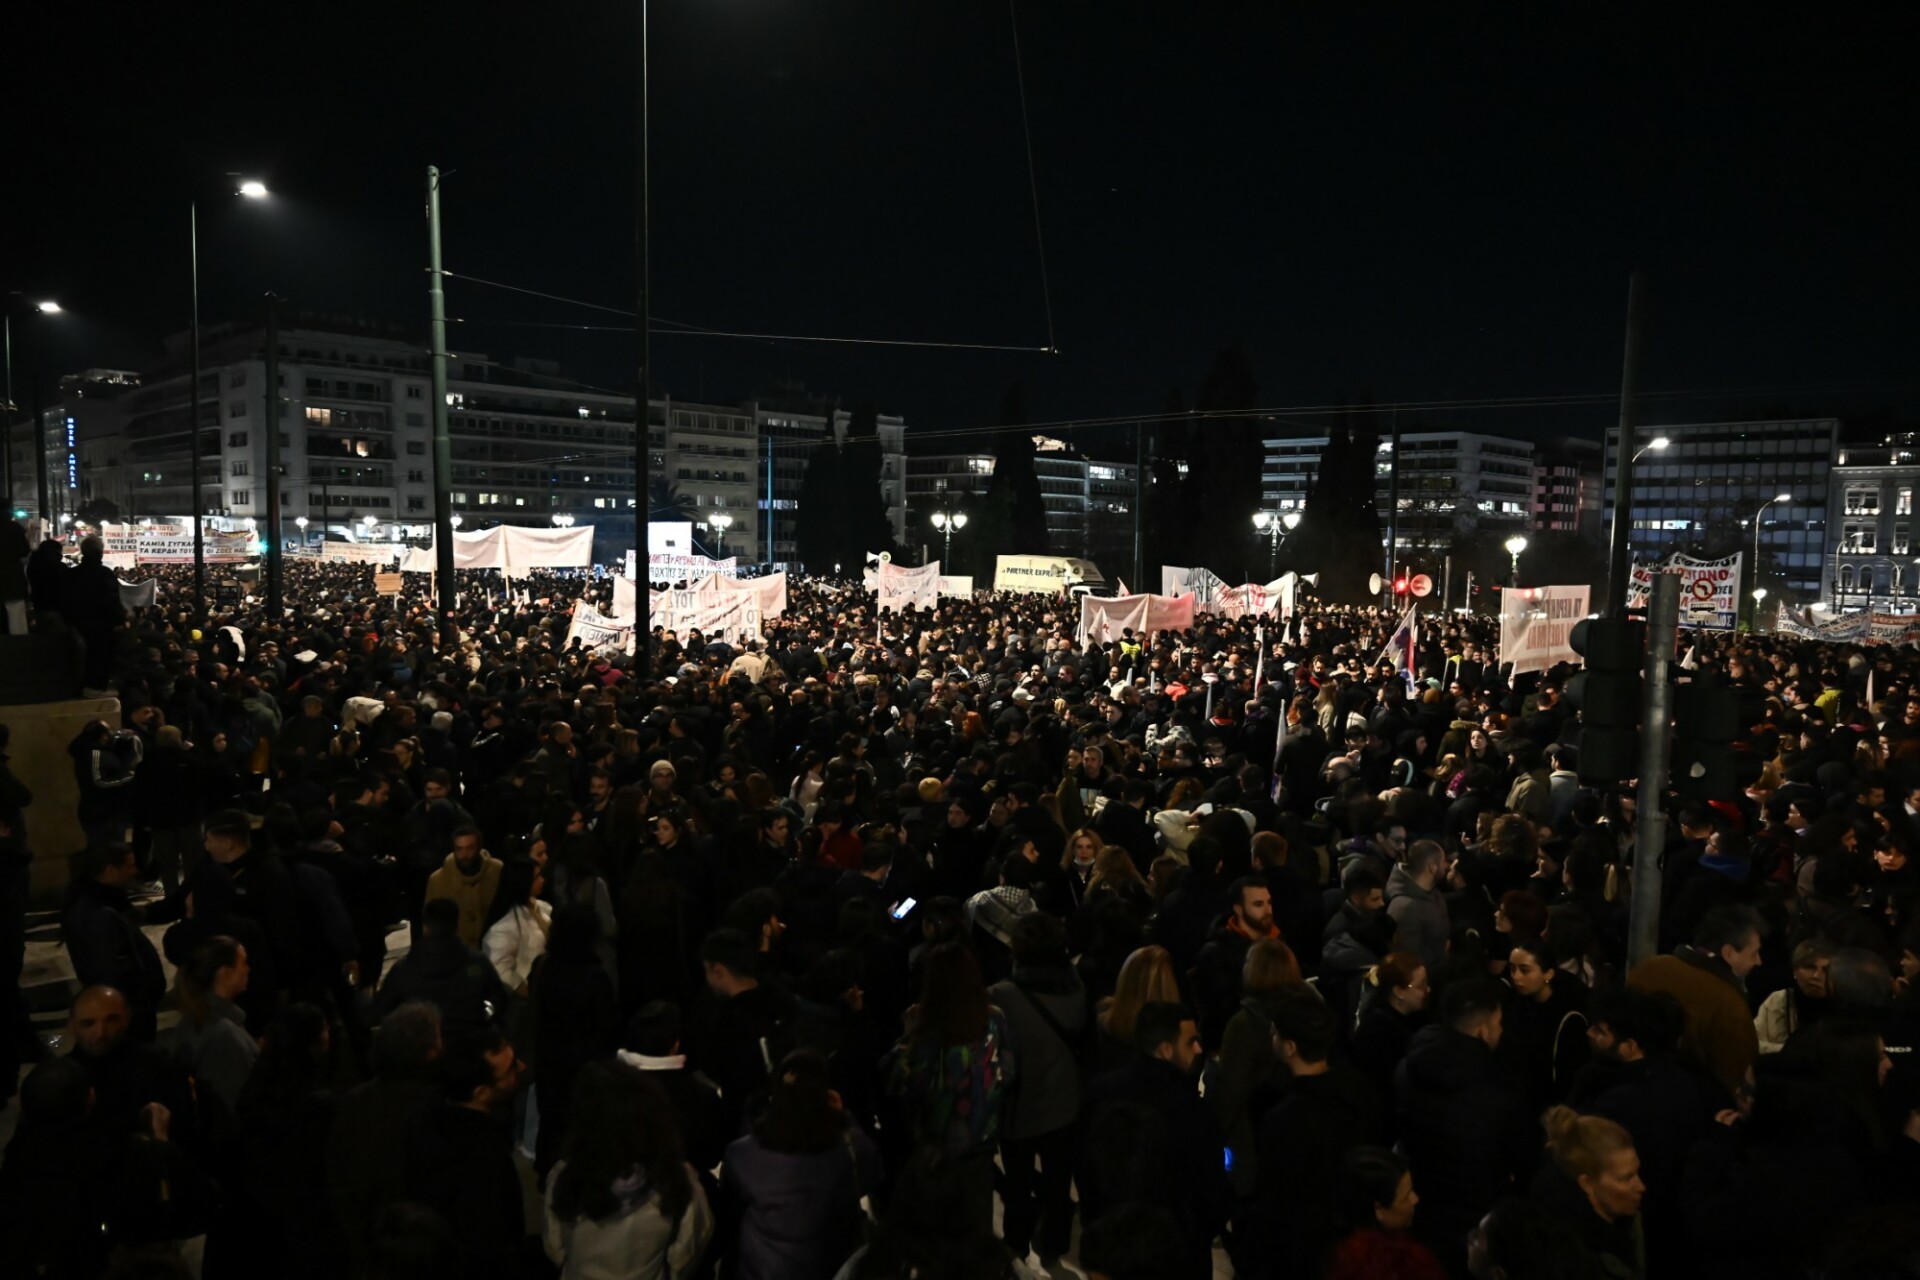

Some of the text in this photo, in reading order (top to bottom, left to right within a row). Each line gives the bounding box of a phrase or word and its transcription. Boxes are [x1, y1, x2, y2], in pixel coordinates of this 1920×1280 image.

[67, 417, 76, 488] HOTEL AMALIA
[1006, 567, 1034, 577] PARTNER
